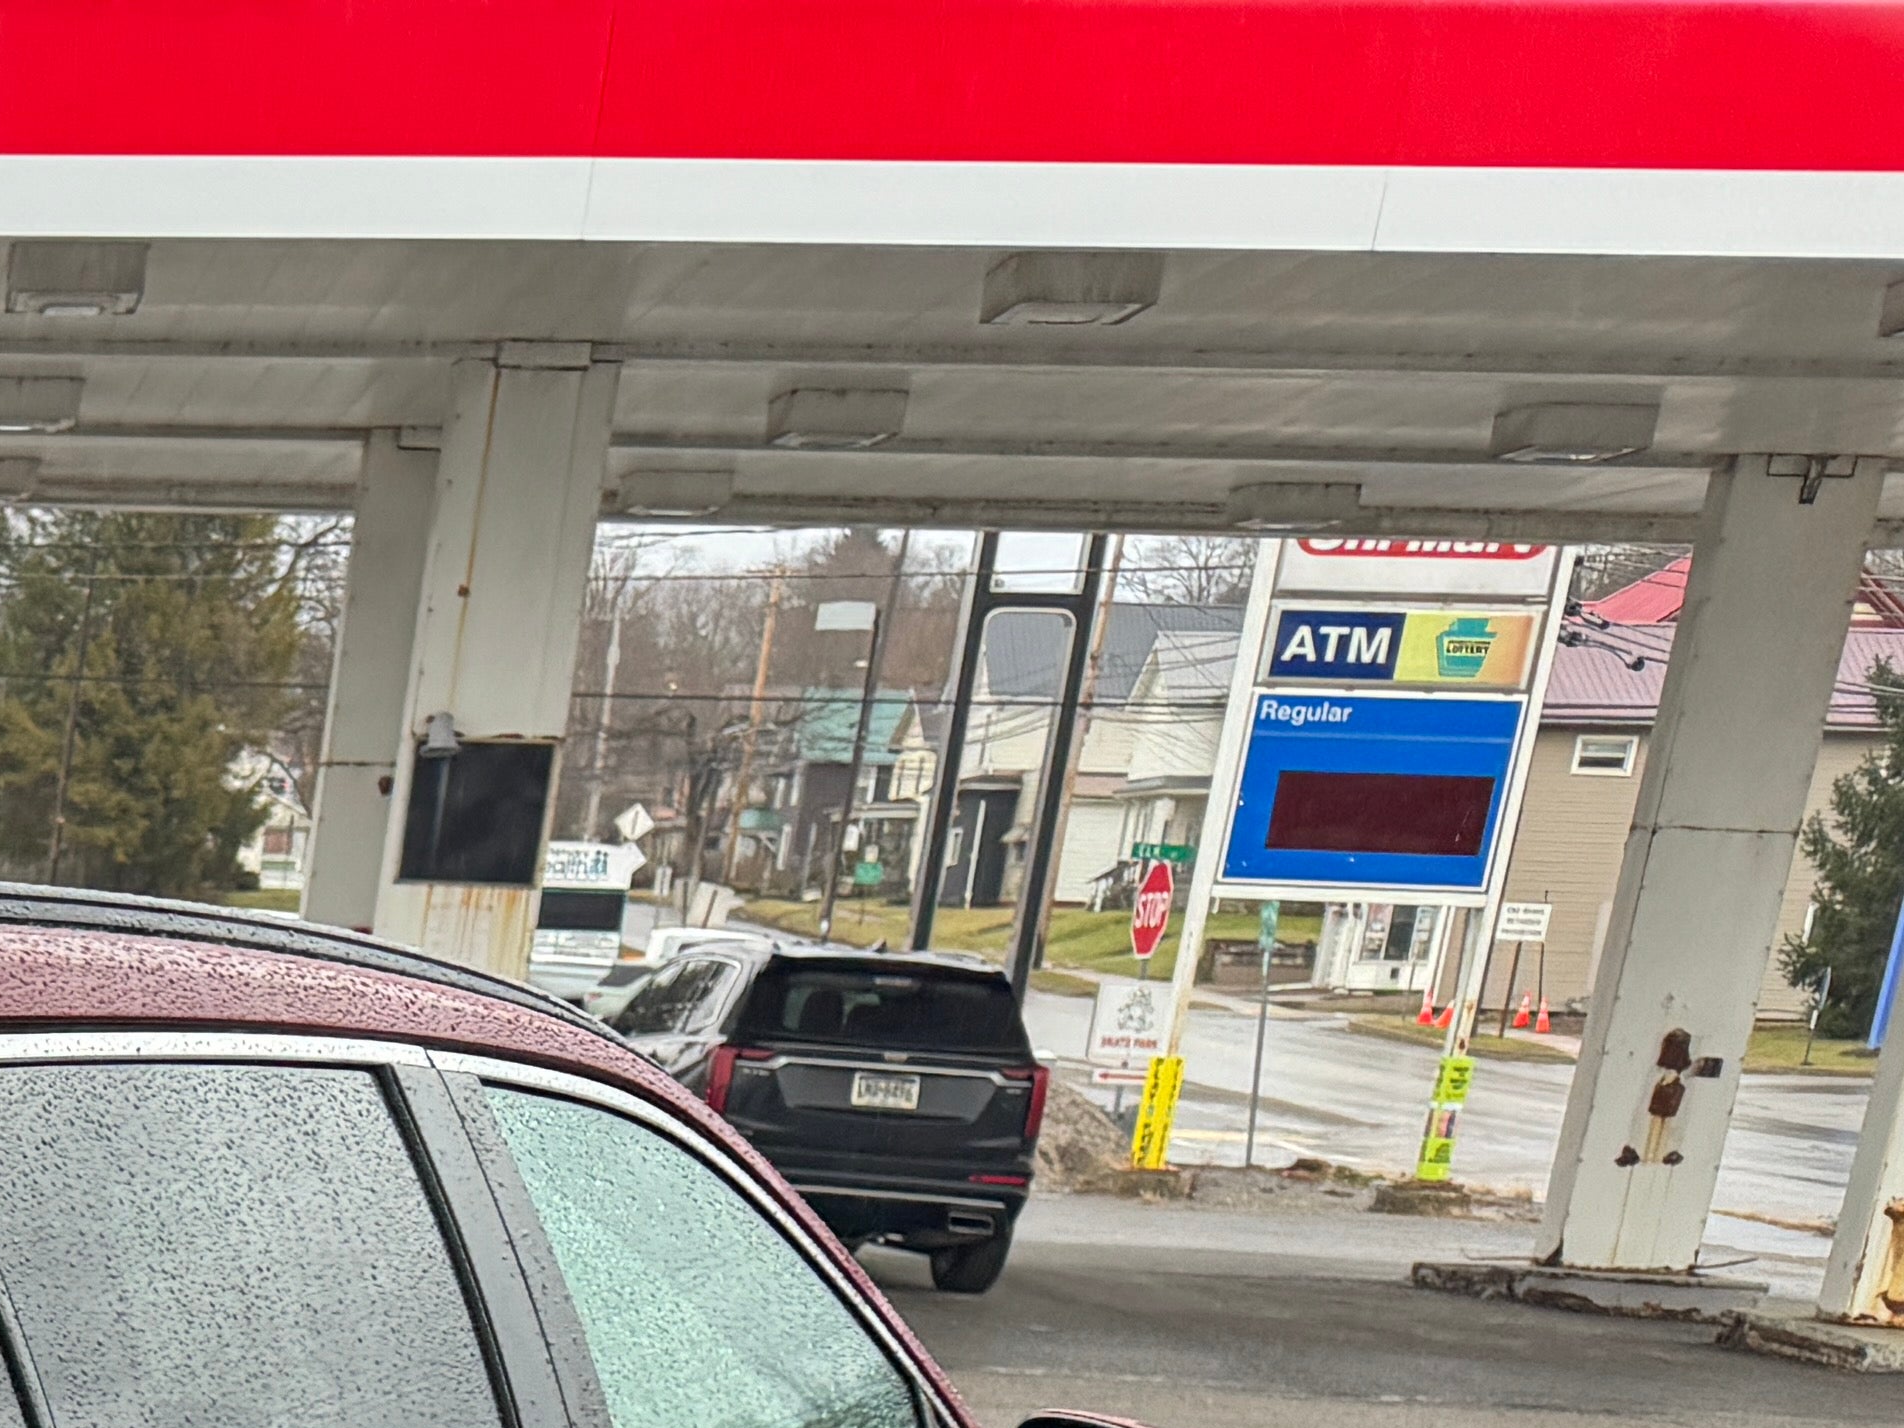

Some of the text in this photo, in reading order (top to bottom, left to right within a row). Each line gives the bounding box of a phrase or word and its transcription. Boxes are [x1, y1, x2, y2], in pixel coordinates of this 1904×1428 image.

[1280, 624, 1393, 664] ATM
[1259, 699, 1353, 727] Regular
[1134, 891, 1170, 929] STOP
